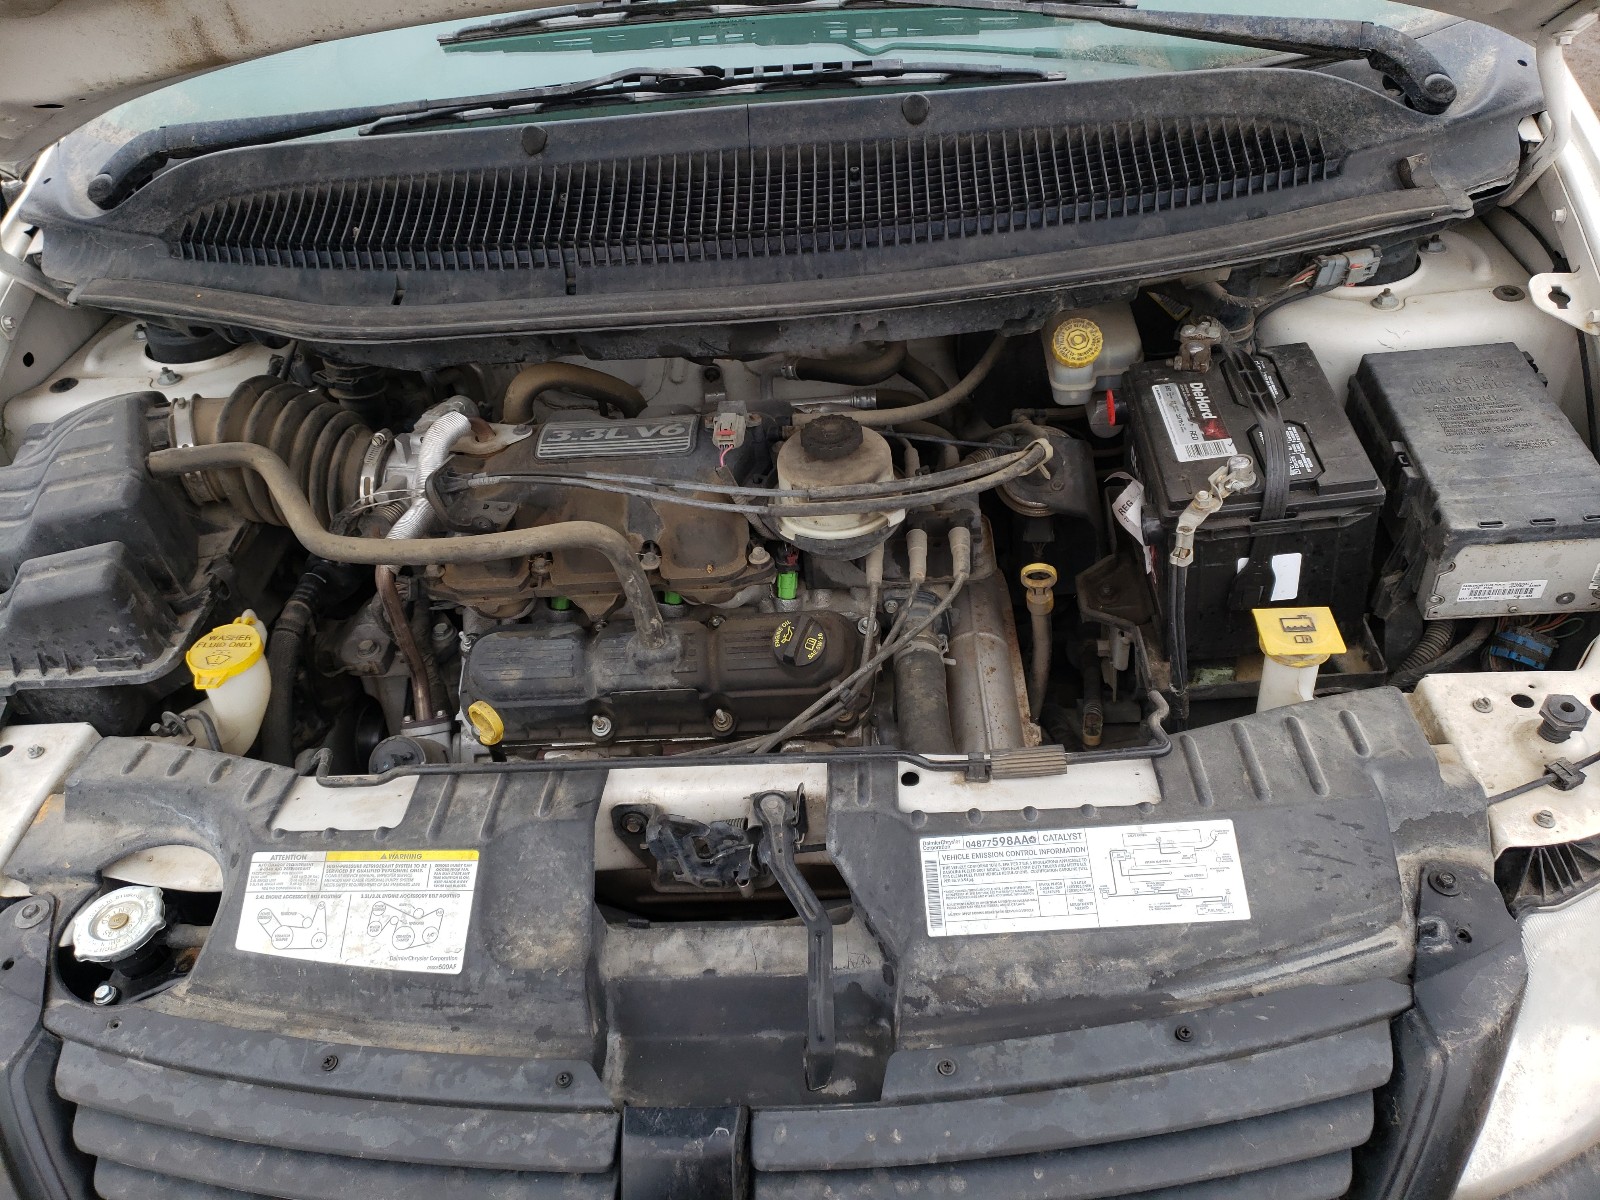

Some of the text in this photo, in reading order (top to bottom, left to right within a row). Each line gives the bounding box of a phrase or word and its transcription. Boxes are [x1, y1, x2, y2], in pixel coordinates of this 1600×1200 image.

[1189, 382, 1218, 419] DieHard
[547, 424, 687, 442] 3.3L V6
[1189, 430, 1200, 441] RED
[1118, 500, 1134, 516] REG
[774, 620, 792, 648] ENGINE OIL
[965, 835, 1029, 848] 04877598AA
[1042, 832, 1083, 842] CATALYST
[942, 846, 1086, 861] VEHICLE EMISSION CONTROL INFORMATION
